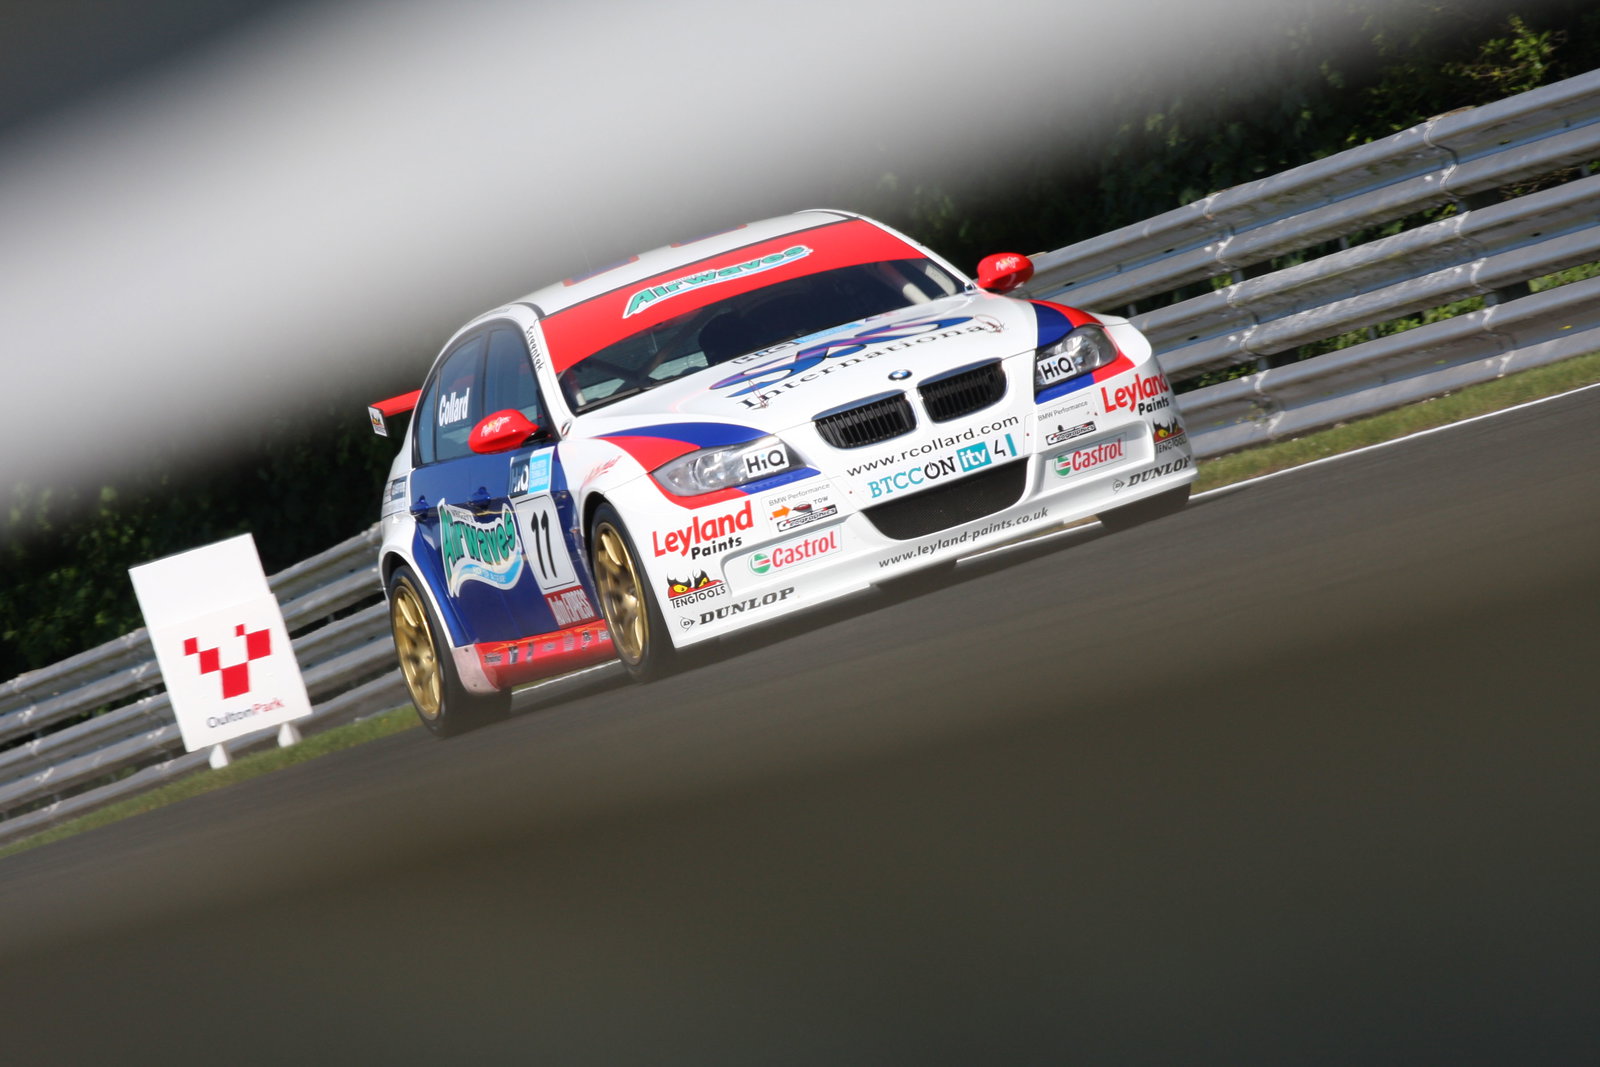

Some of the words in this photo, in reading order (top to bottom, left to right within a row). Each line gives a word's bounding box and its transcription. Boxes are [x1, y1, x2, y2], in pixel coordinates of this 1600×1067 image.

[737, 319, 1002, 410] International
[1040, 357, 1074, 380] HiQ
[438, 387, 470, 427] Collard
[1053, 401, 1088, 416] Performance
[1138, 396, 1170, 416] Paints
[744, 449, 787, 474] HiQ
[846, 415, 1019, 477] www.rcollard.com
[1071, 438, 1124, 471] Castrol
[768, 495, 788, 506] BMW
[787, 484, 831, 501] Performance
[812, 495, 829, 505] TOW
[531, 509, 558, 580] 11
[652, 500, 754, 558] Leyland
[878, 506, 1049, 568] www.leyland-paints.co.uk
[691, 536, 743, 560] Paints
[772, 531, 837, 568] Castrol
[699, 586, 795, 626] DUNLOP
